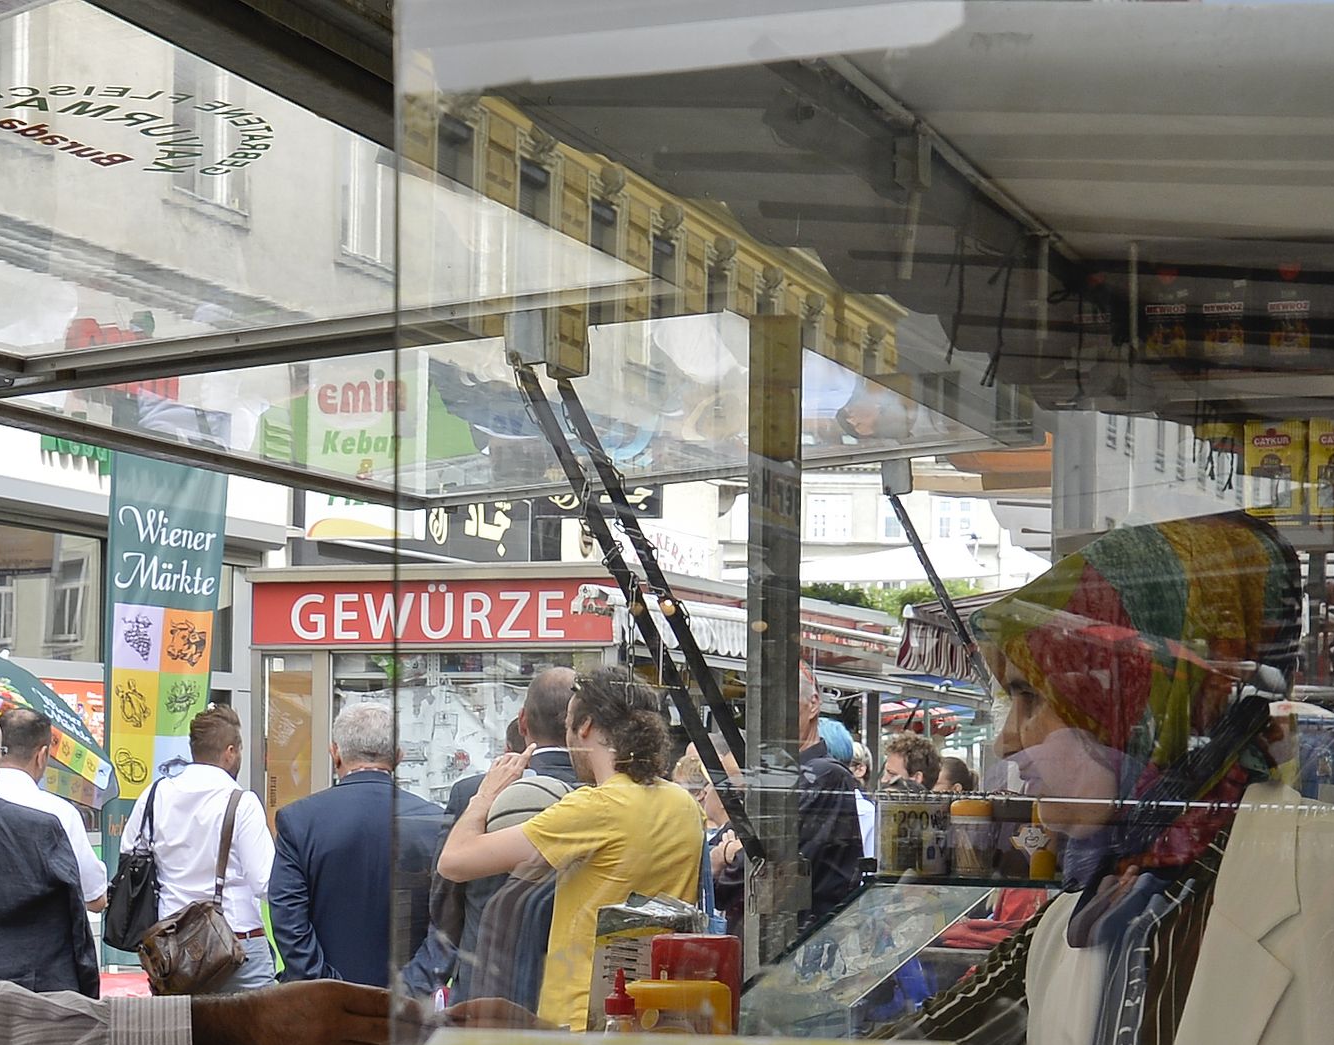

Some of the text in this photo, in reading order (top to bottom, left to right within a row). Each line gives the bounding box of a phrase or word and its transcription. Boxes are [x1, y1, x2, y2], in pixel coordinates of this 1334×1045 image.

[118, 505, 217, 551] Wiener
[114, 552, 216, 596] Märkte
[290, 583, 565, 640] GEWÜRZE
